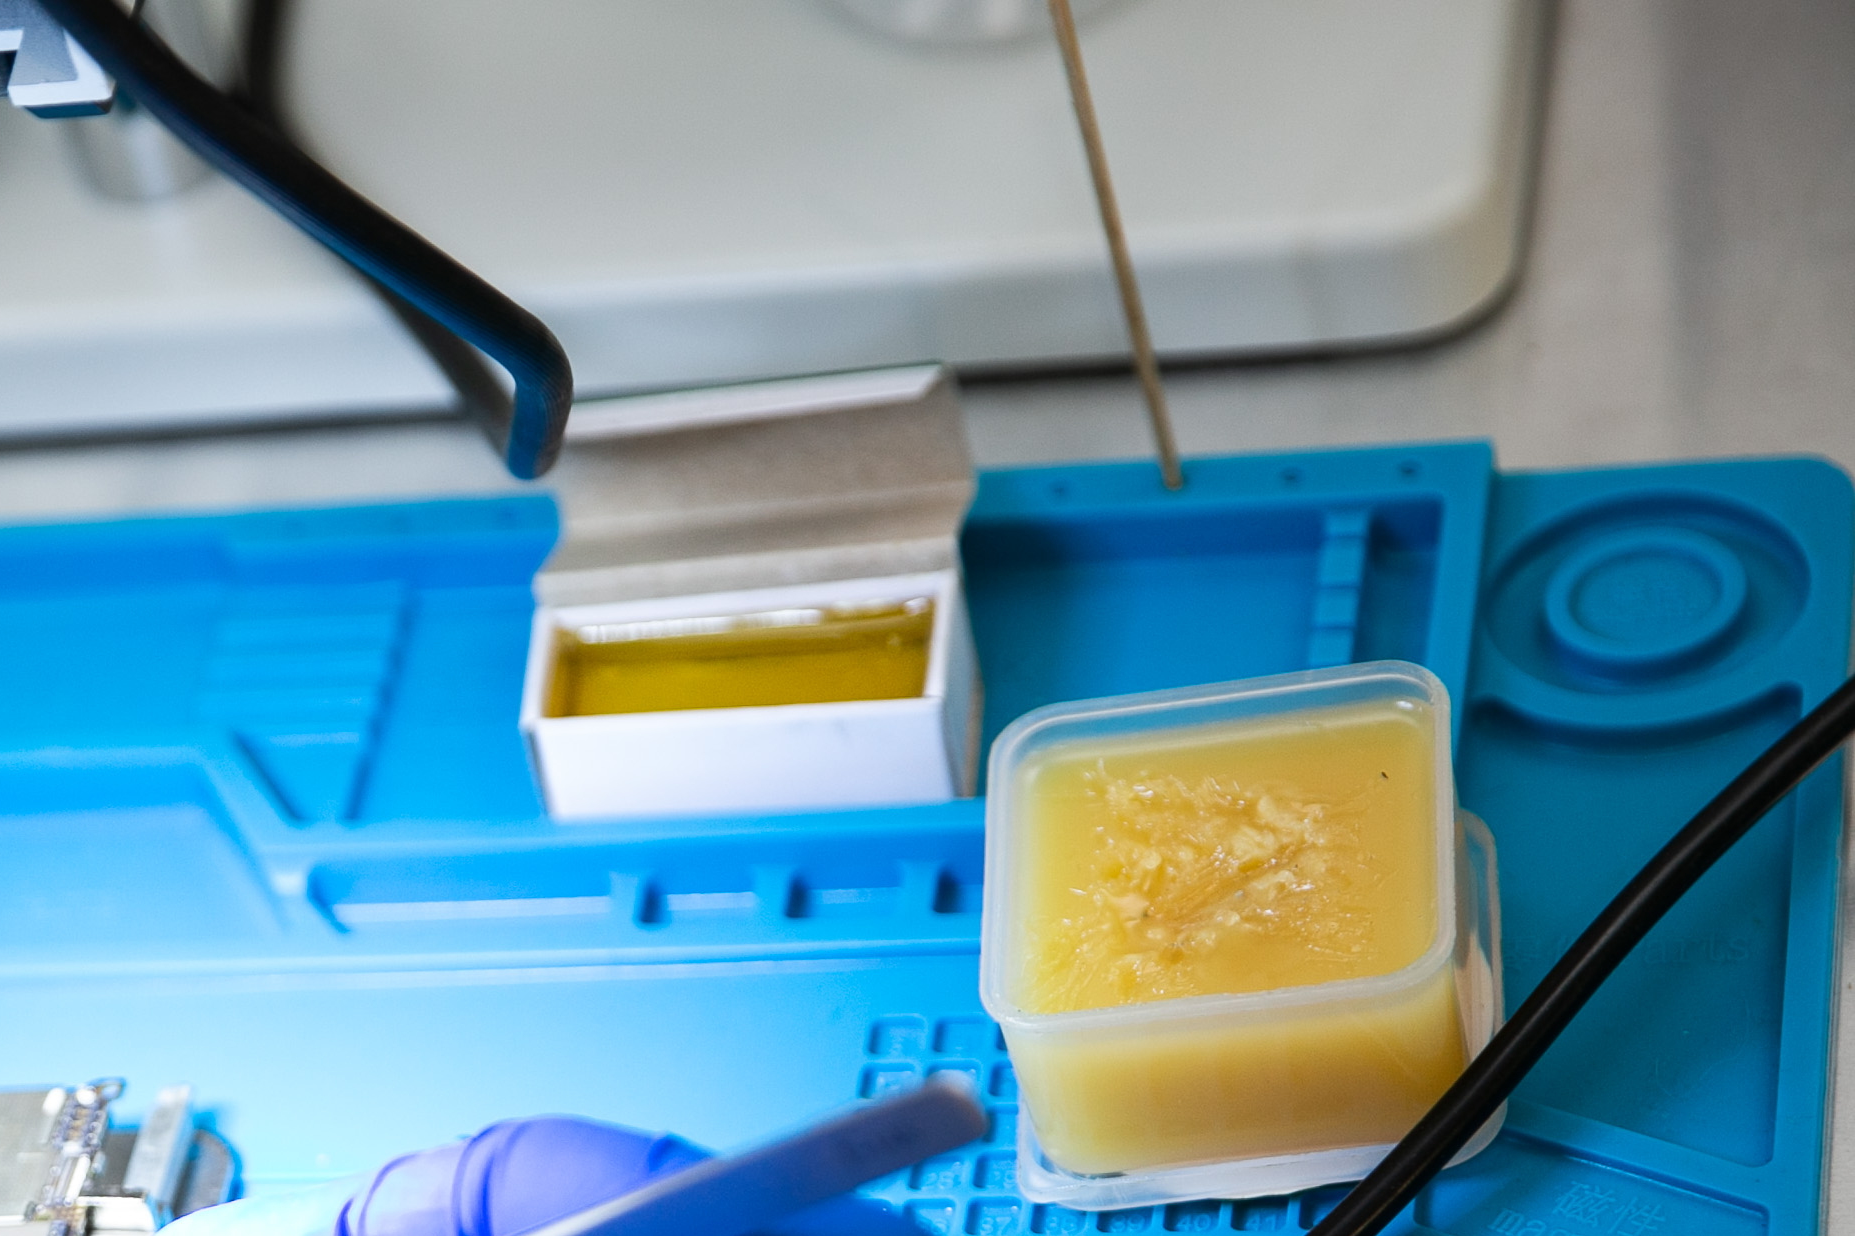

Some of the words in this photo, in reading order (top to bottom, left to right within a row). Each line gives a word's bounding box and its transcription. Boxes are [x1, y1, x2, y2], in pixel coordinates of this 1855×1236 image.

[980, 1216, 1011, 1236] 37
[1177, 1214, 1211, 1232] 40
[1246, 1214, 1276, 1232] 41
